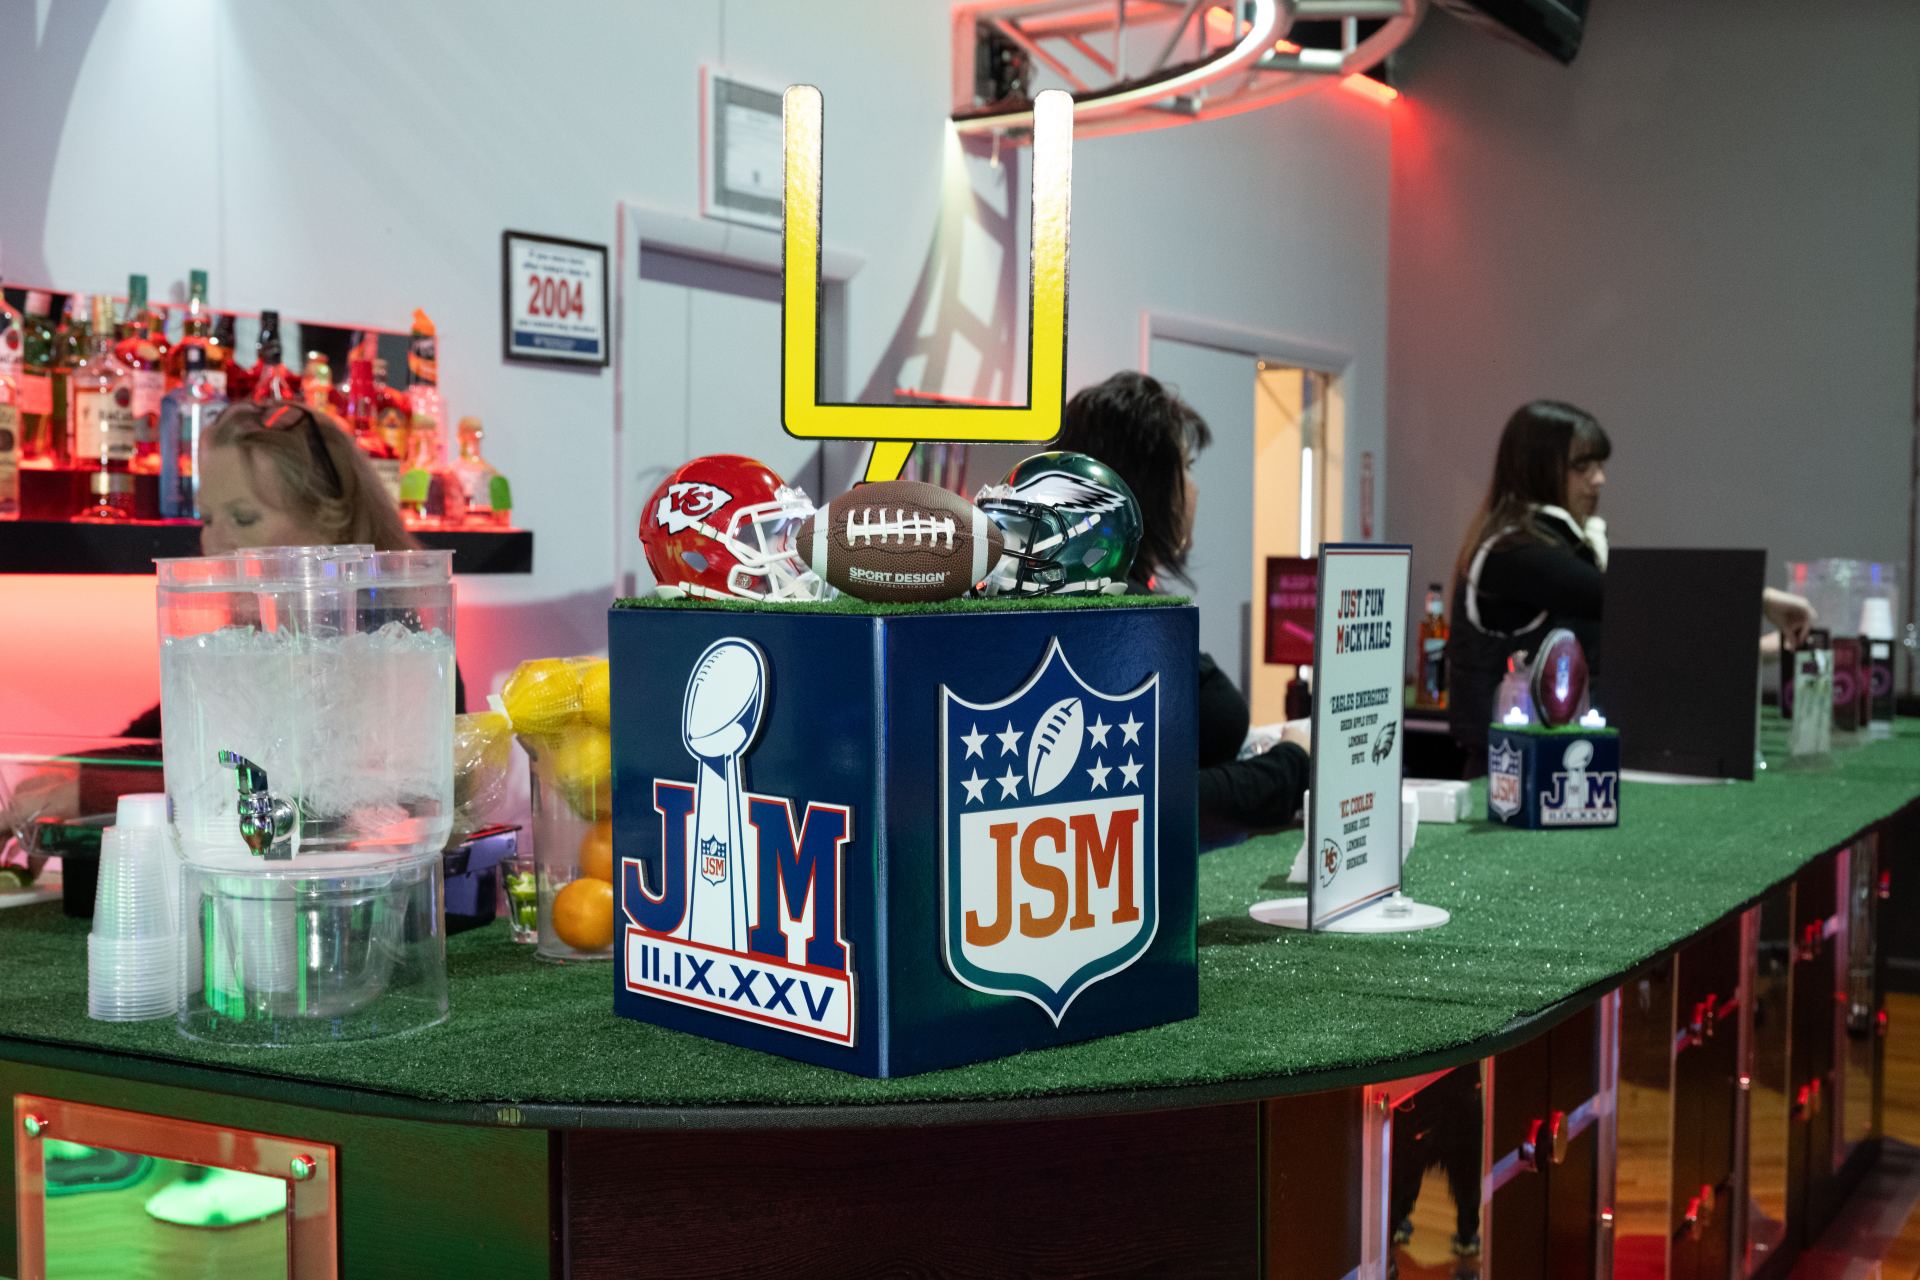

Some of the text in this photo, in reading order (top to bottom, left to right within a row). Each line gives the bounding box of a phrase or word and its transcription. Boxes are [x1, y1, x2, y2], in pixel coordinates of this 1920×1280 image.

[528, 274, 585, 319] 2004
[849, 567, 951, 582] SPORT DESIGN
[1338, 589, 1362, 619] JUST
[1364, 588, 1385, 617] FUN
[703, 857, 725, 877] JSM
[966, 808, 1140, 947] JSM
[641, 945, 835, 1022] II.IX.XXV
